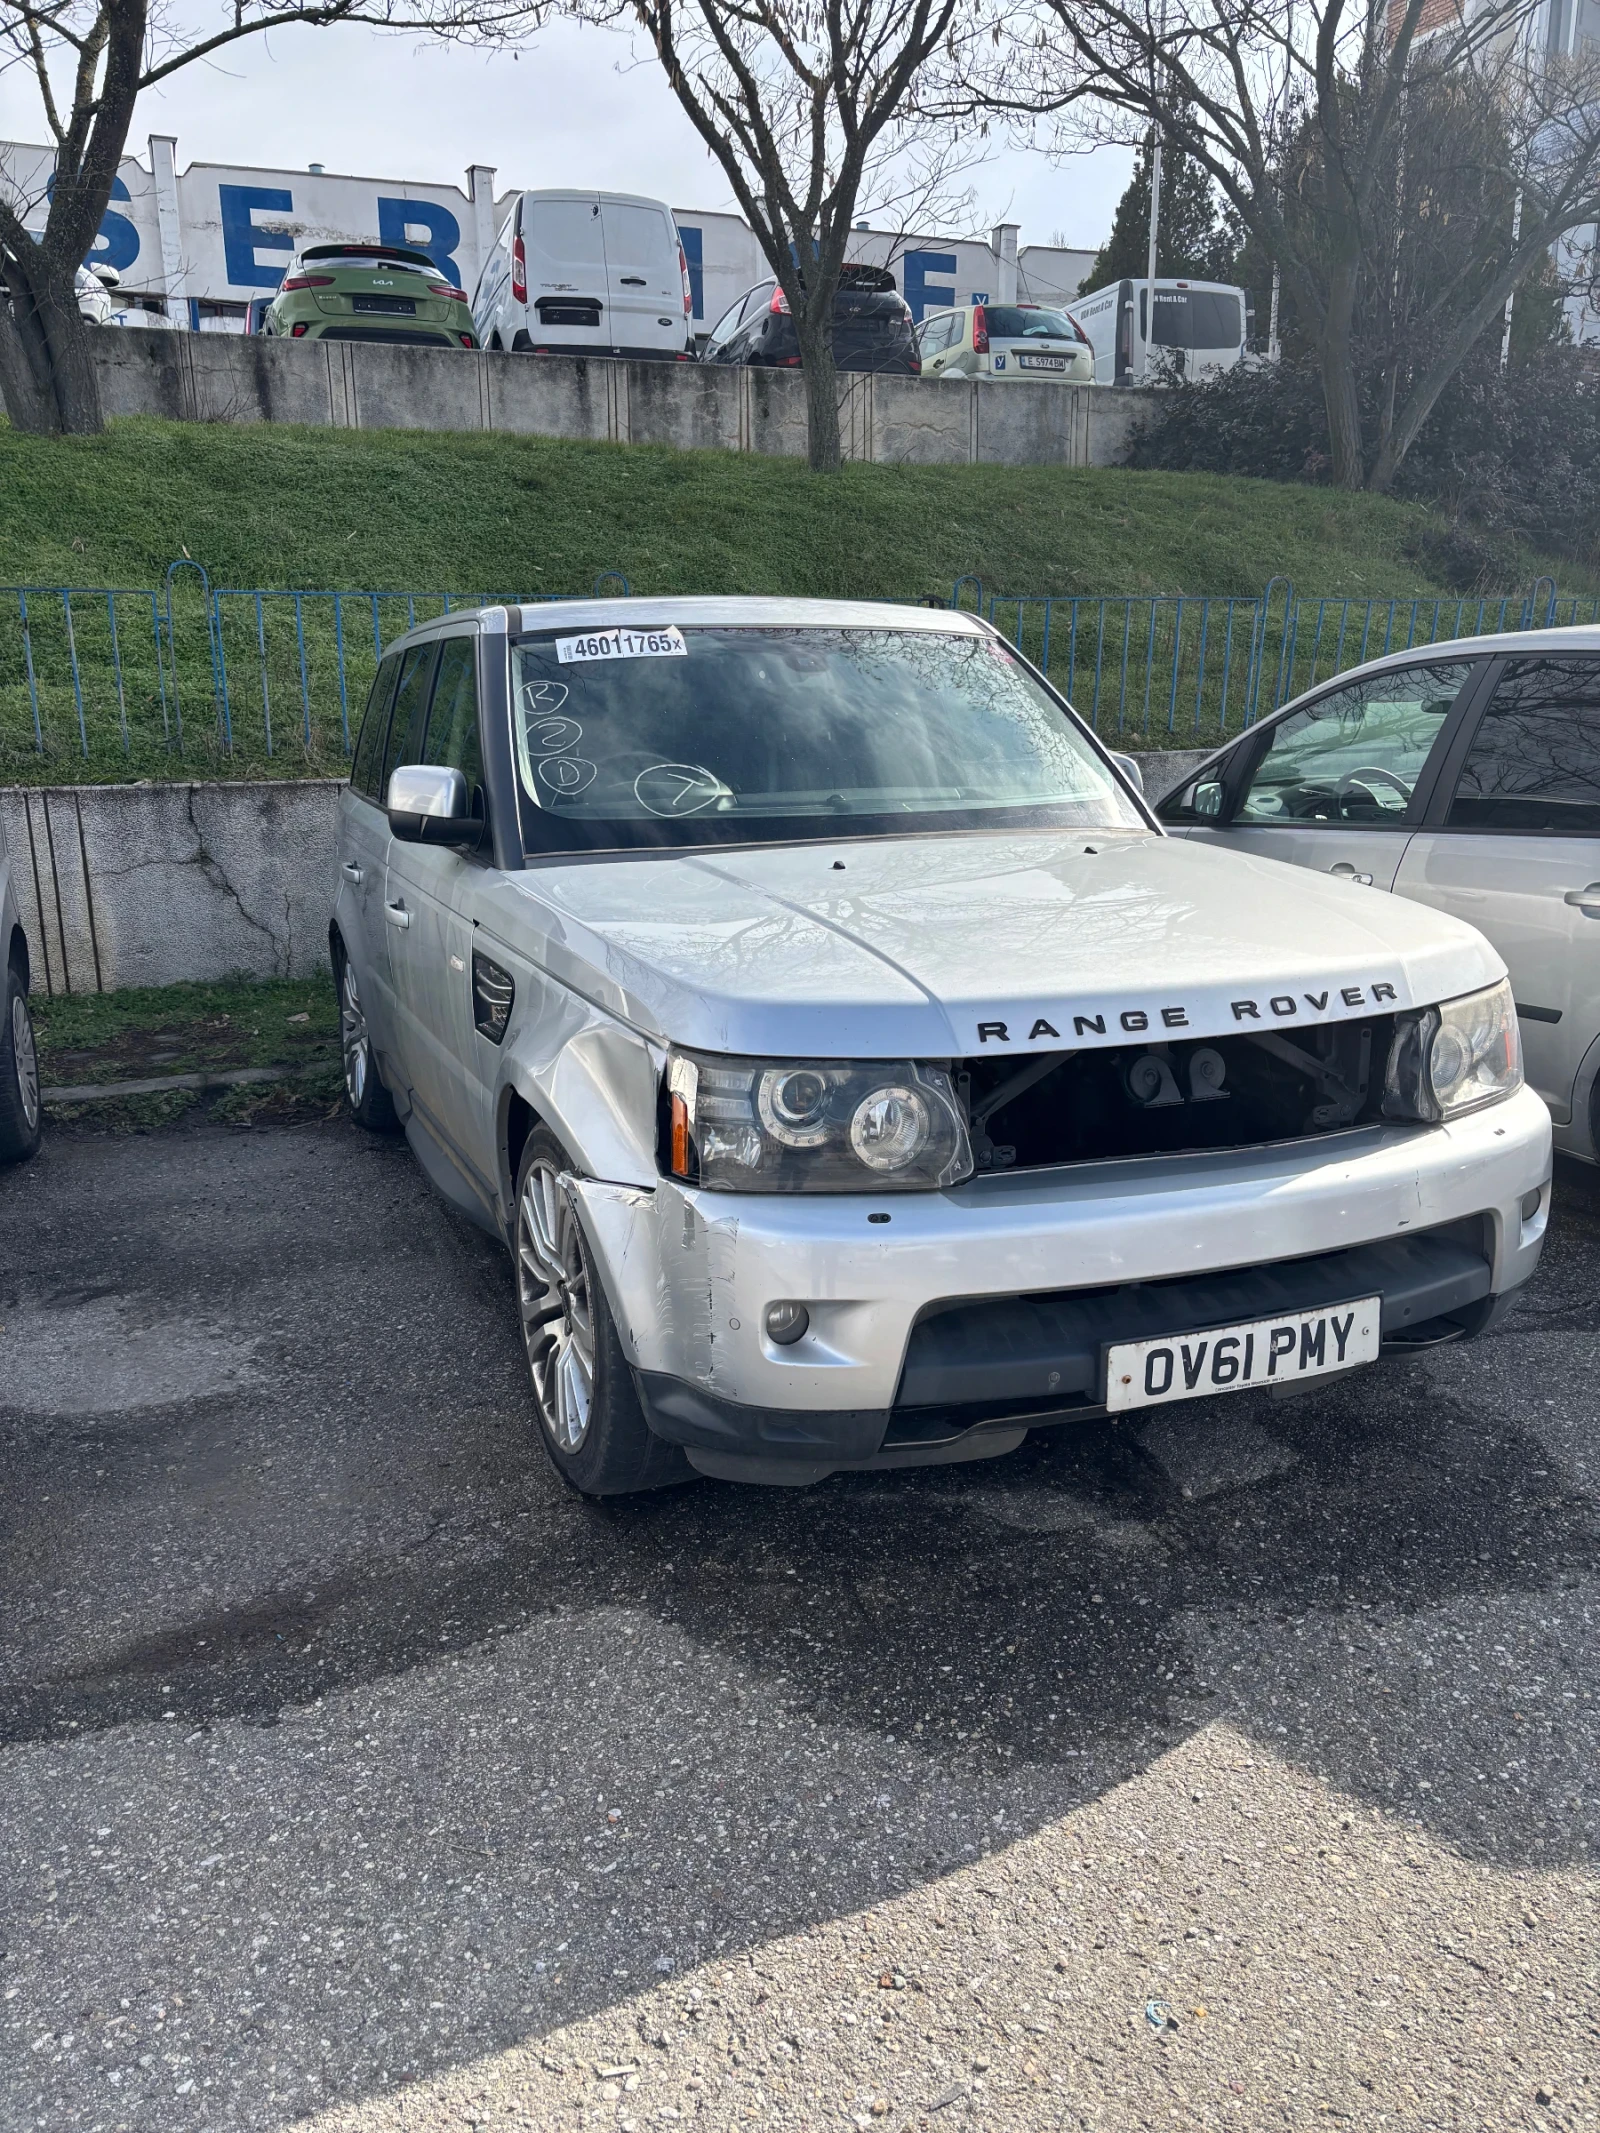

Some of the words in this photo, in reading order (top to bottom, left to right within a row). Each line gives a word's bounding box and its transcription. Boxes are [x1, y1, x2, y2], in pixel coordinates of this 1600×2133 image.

[978, 1007, 1189, 1042] RANGE
[1231, 982, 1398, 1020] ROVER
[1144, 1333, 1254, 1396] OV61
[1267, 1313, 1354, 1376] PMY
